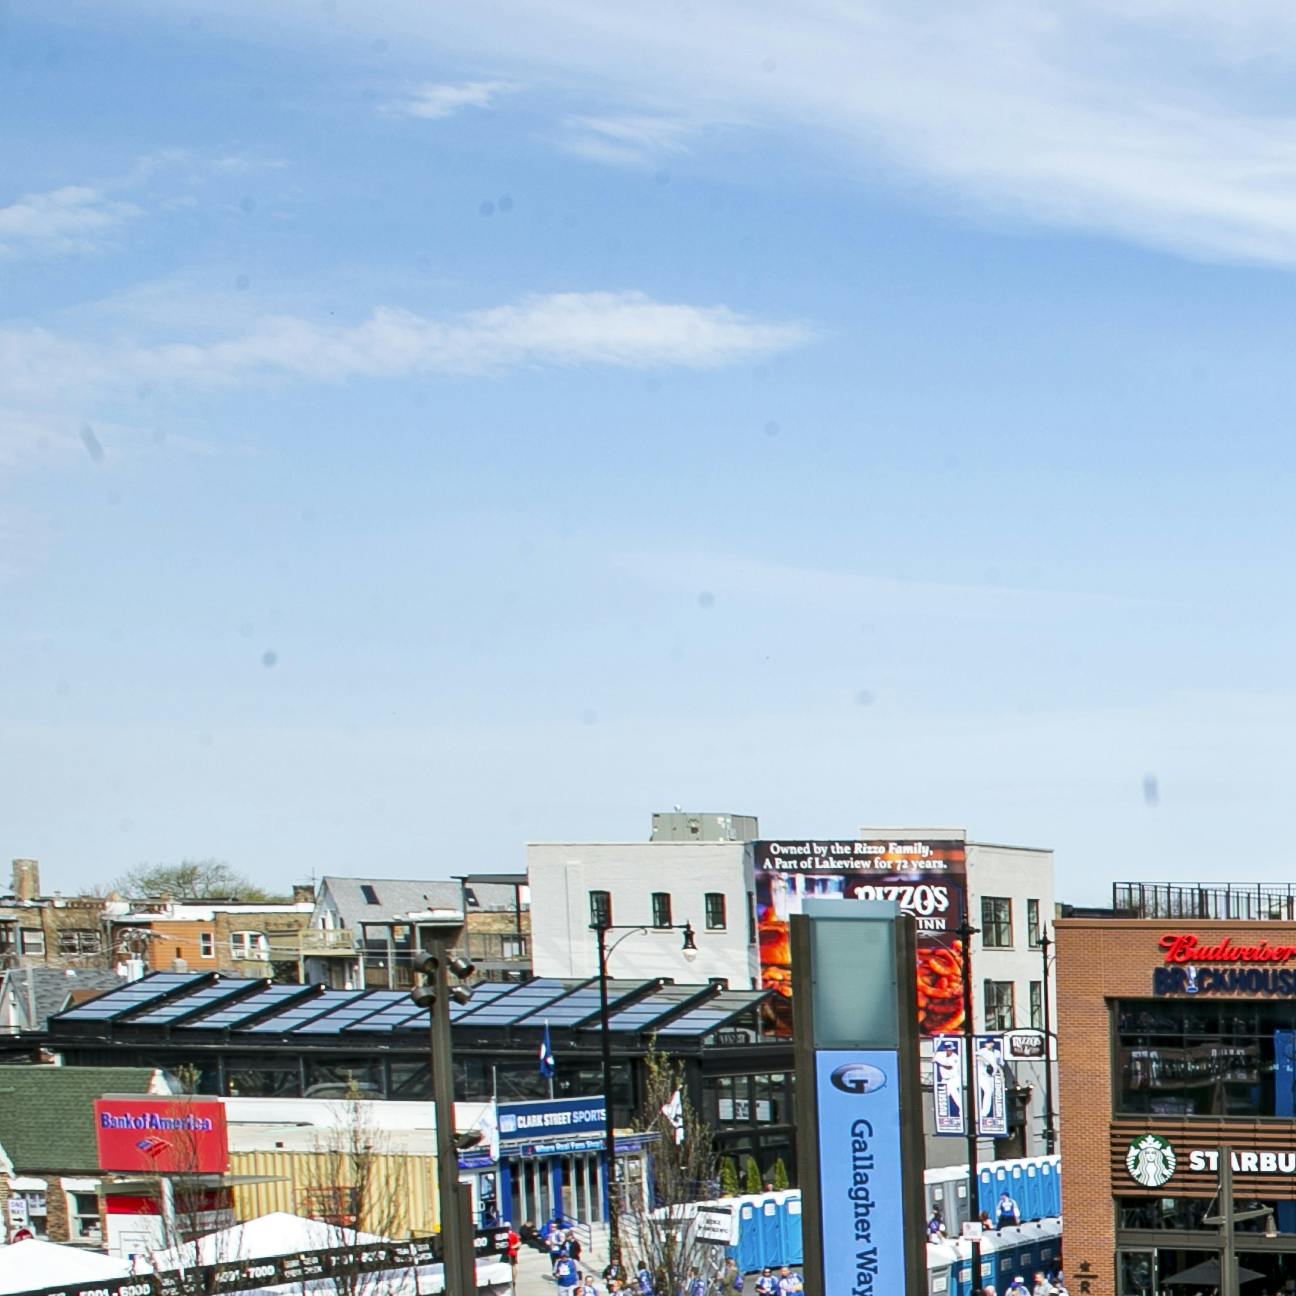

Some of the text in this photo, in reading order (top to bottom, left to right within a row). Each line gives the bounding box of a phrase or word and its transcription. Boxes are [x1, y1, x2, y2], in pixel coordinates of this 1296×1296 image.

[770, 842, 934, 858] Owned by the Rizzo Family,
[763, 858, 948, 871] A Part of Lakeview for 72 years.
[918, 918, 946, 930] INN
[101, 1112, 213, 1131] Bank of America
[517, 1108, 607, 1129] CLARK STREET SPORTS
[847, 1118, 876, 1244] Gallagher
[249, 1265, 276, 1279] 7000
